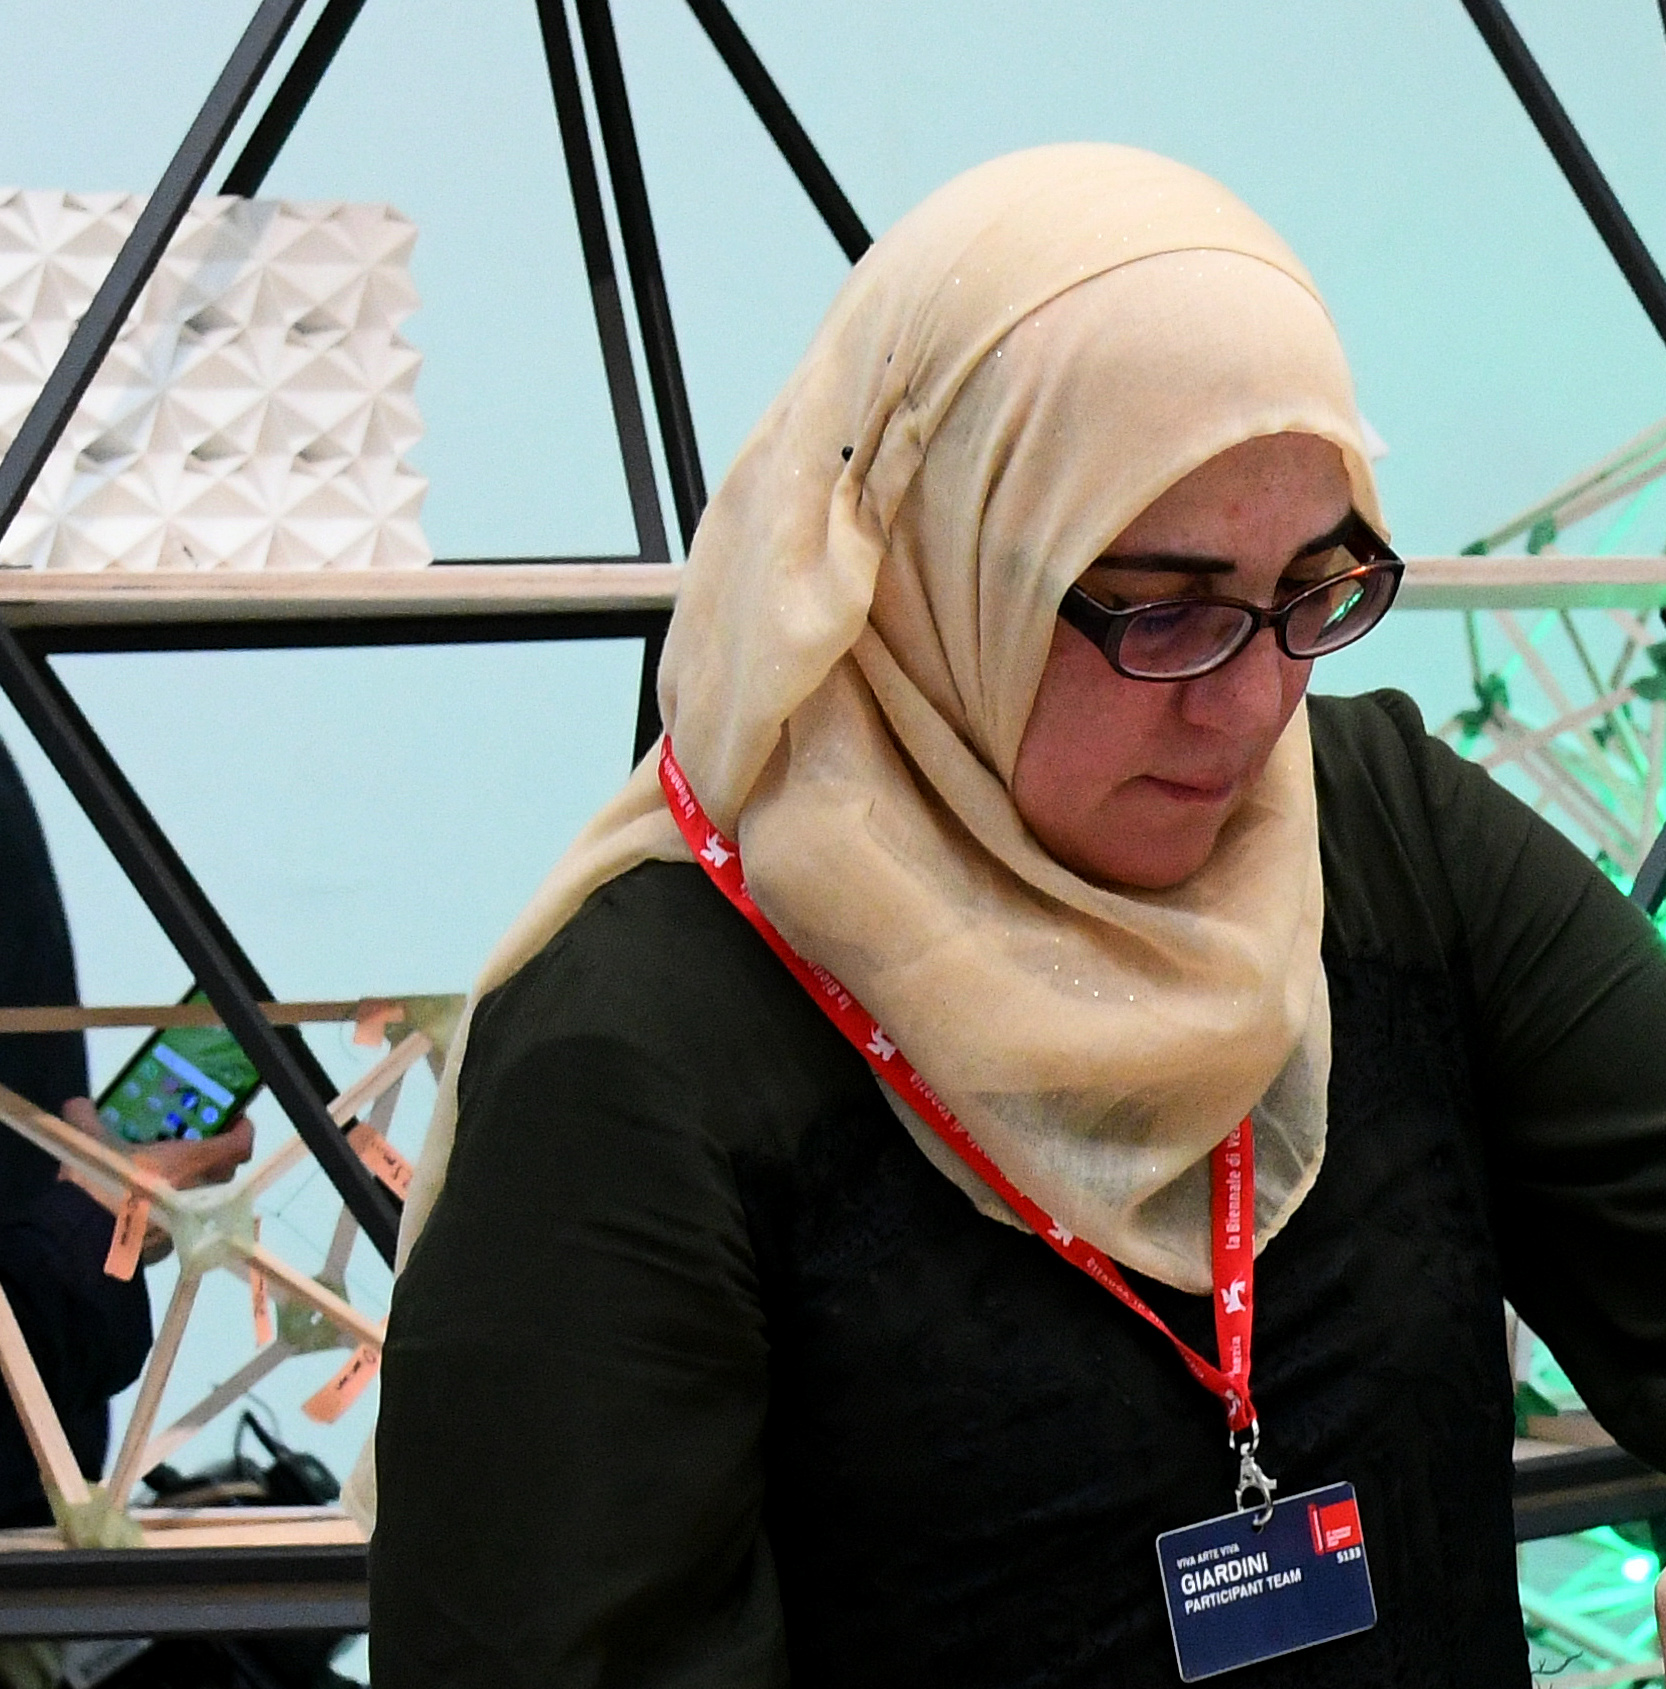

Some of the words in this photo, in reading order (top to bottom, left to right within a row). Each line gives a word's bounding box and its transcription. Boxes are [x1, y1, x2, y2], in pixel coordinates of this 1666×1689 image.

[1225, 1153, 1241, 1168] di
[1225, 1171, 1241, 1234] Biennale
[1225, 1236, 1241, 1250] la
[1176, 1556, 1196, 1570] VIVA
[1197, 1549, 1219, 1563] ARTE
[1220, 1543, 1240, 1556] VIVA
[1181, 1552, 1268, 1595] GIARDINI
[1185, 1579, 1264, 1615] PARTICIPANT
[1266, 1568, 1302, 1590] TEAM
